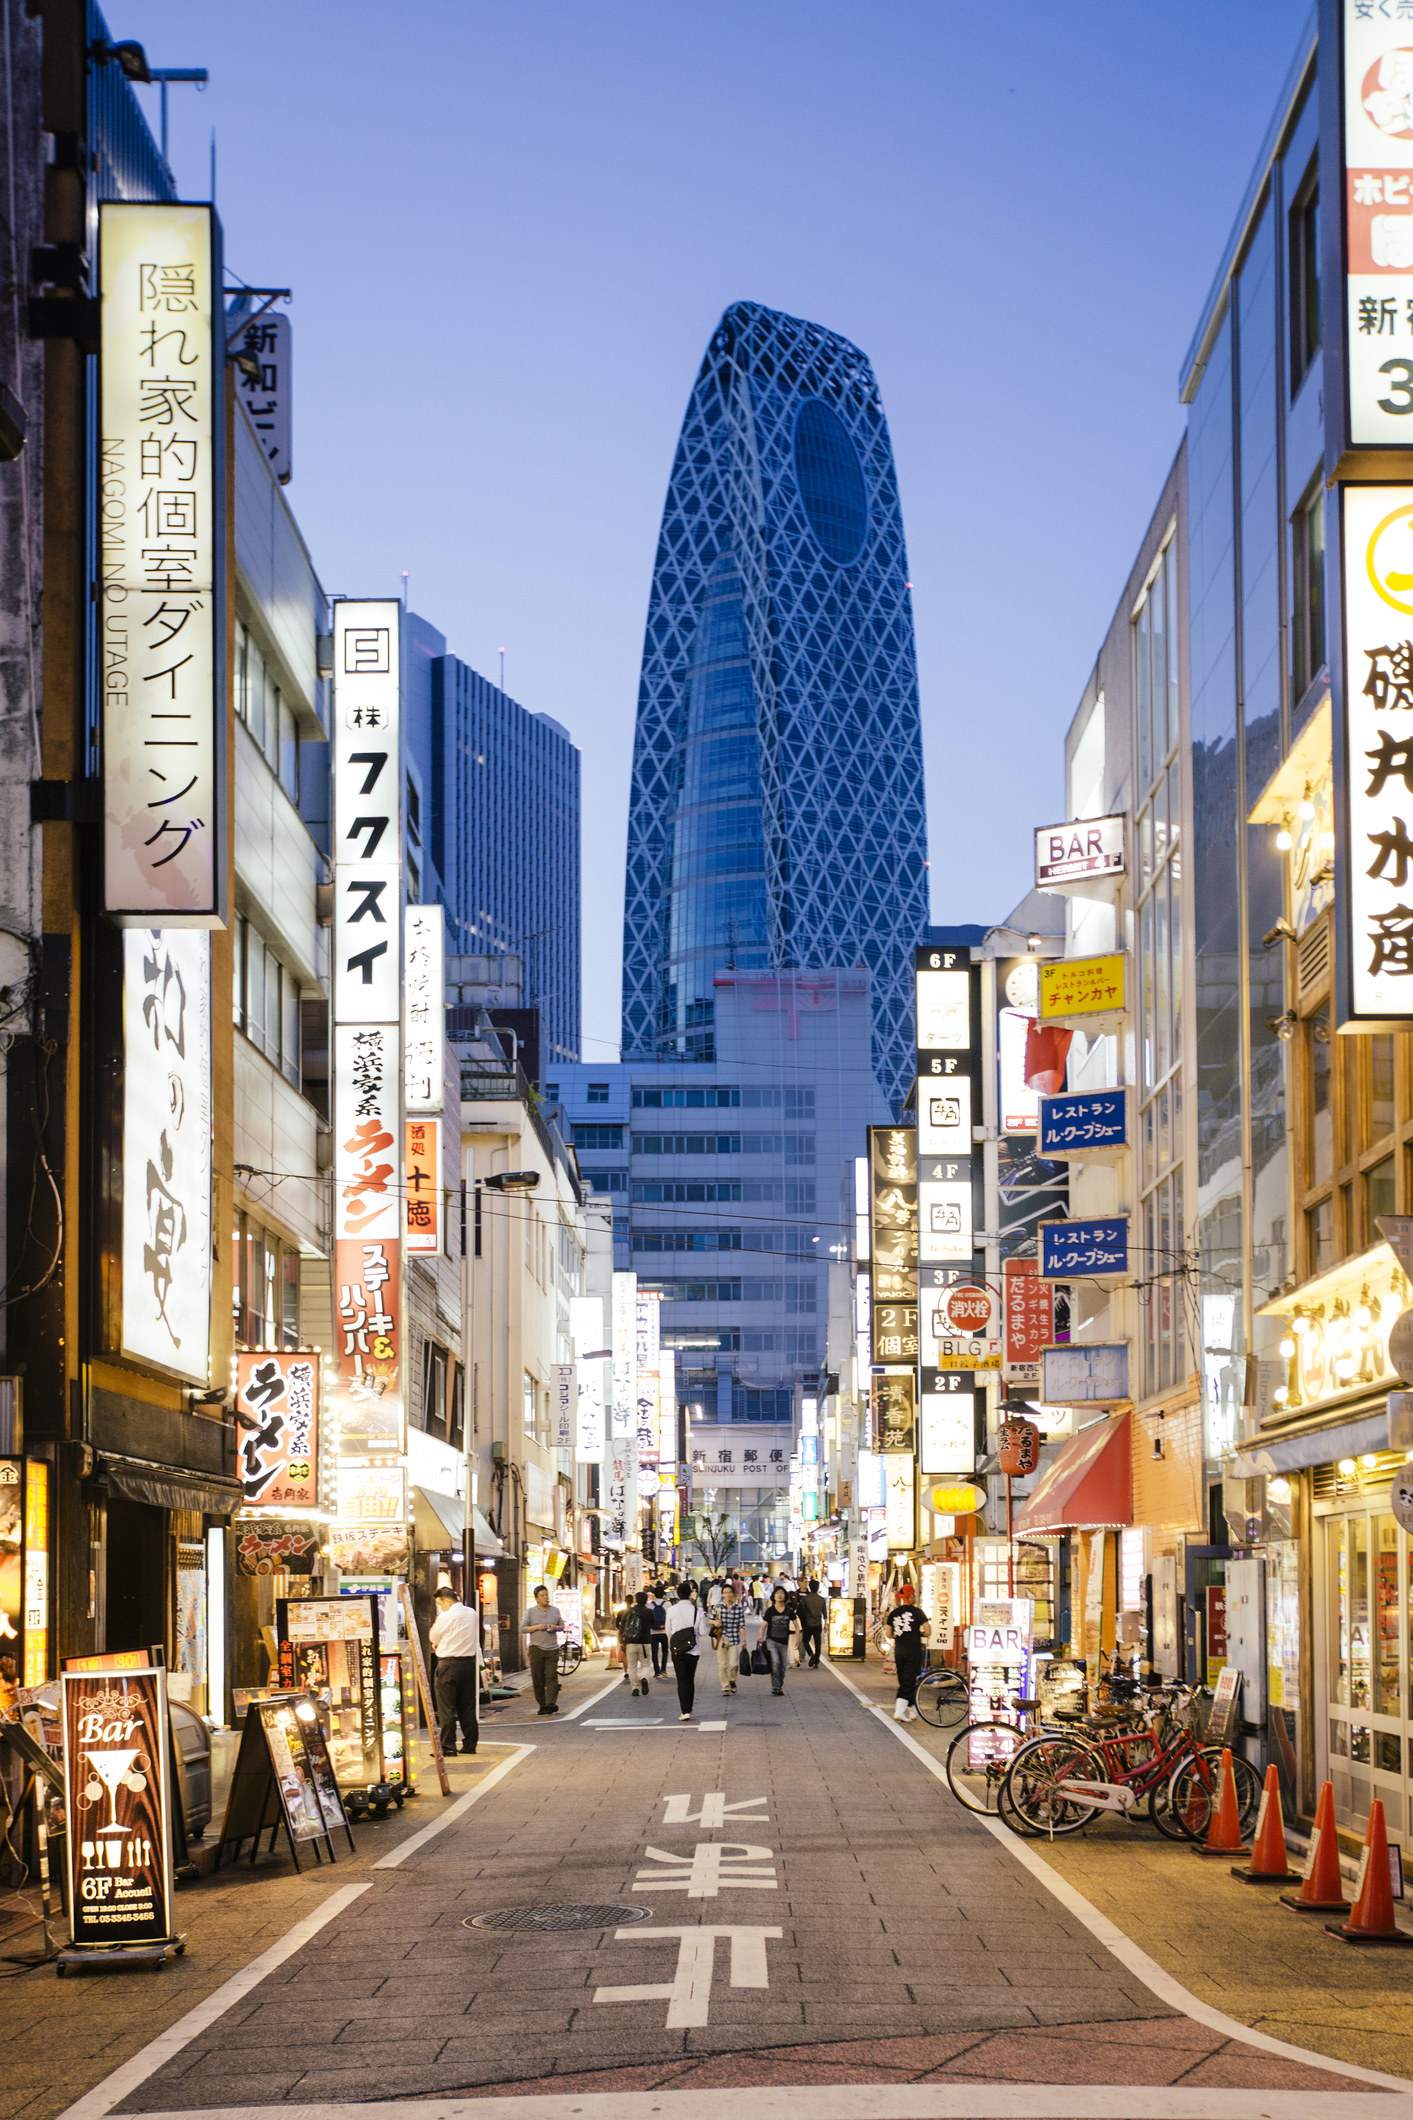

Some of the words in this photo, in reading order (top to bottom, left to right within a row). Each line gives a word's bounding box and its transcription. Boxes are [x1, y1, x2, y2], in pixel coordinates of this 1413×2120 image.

[1353, 174, 1413, 205] ホビ
[102, 438, 126, 551] NAGOMI
[137, 262, 205, 868] 隠れ家的個室ダイニング
[103, 564, 128, 604] NO
[105, 615, 129, 707] UTAGE
[1050, 829, 1104, 863] BAR
[346, 752, 390, 985] フクスイ
[929, 953, 957, 968] 6F
[1044, 969, 1056, 979] 3F
[1049, 986, 1118, 1008] チャンカヤ
[931, 1059, 958, 1073] 5F
[1052, 1103, 1116, 1120] レストラン
[410, 1125, 426, 1156] 酒処
[343, 1118, 394, 1234] ラーメン
[932, 1165, 959, 1179] 4F
[1053, 1230, 1117, 1245] レストラン
[934, 1270, 960, 1284] 3F
[881, 1309, 918, 1327] 2F
[951, 1300, 989, 1318] 消火栓
[1010, 1277, 1026, 1349] だるまや
[877, 1335, 918, 1356] 個室
[943, 1341, 981, 1356] BLG
[935, 1376, 961, 1391] 2F
[882, 1384, 907, 1447] 清香苑
[243, 1360, 286, 1501] ラーメン
[692, 1449, 797, 1463] 新宿郵便
[743, 1465, 768, 1473] POST
[238, 1533, 316, 1556] ラーメン
[332, 1526, 403, 1545] 鉄板ステーキ
[973, 1629, 1019, 1650] BAR
[77, 1713, 144, 1743] Bar
[81, 1876, 113, 1900] 6F
[113, 1876, 135, 1887] Bar
[113, 1886, 153, 1899] Accueil
[82, 1915, 99, 1924] TEL
[592, 1792, 783, 2029] 止まれ
